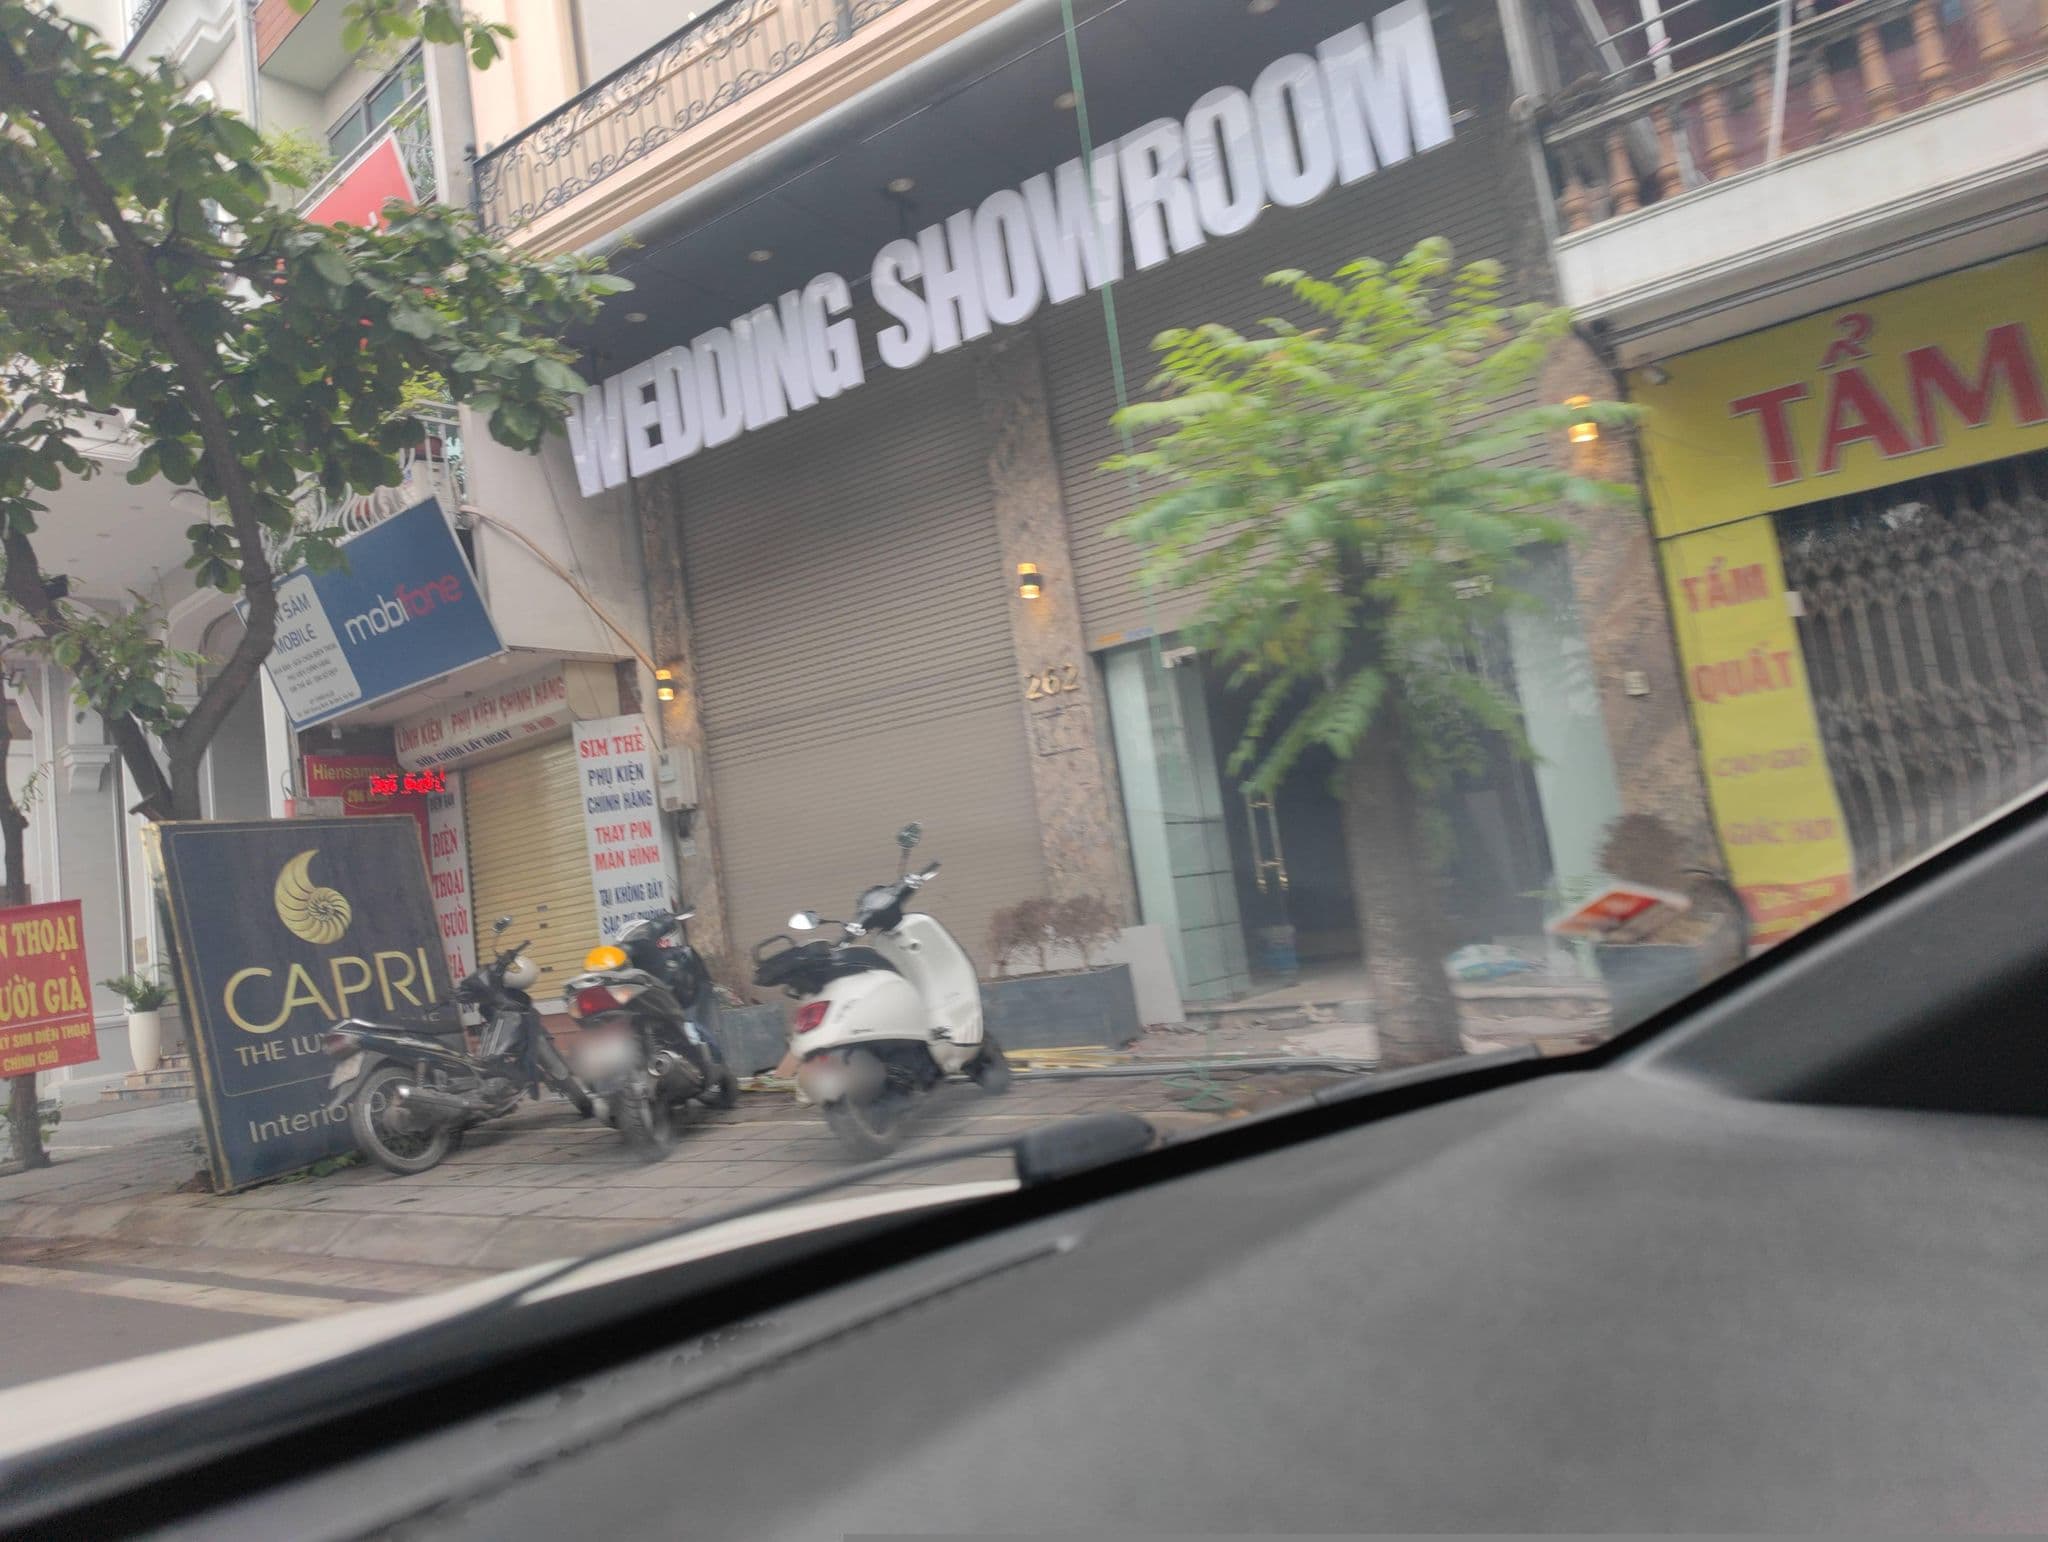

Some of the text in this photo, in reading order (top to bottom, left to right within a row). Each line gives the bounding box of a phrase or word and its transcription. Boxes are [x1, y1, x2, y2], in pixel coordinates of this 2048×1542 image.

[566, 0, 1455, 498] WEDDING SHOWROOM
[1728, 312, 2048, 488] TẨM
[344, 575, 463, 646] mobifone
[276, 623, 318, 656] MOBILE
[1023, 663, 1081, 701] 262
[579, 738, 609, 759] SIM
[594, 821, 653, 845] THAY PIN
[12, 915, 78, 960] THOẠI
[0, 966, 87, 1022] ƯỜI GIÀ
[224, 946, 438, 1034] CAPRI
[234, 1032, 328, 1067] THE LU
[249, 1102, 352, 1143] Interio
